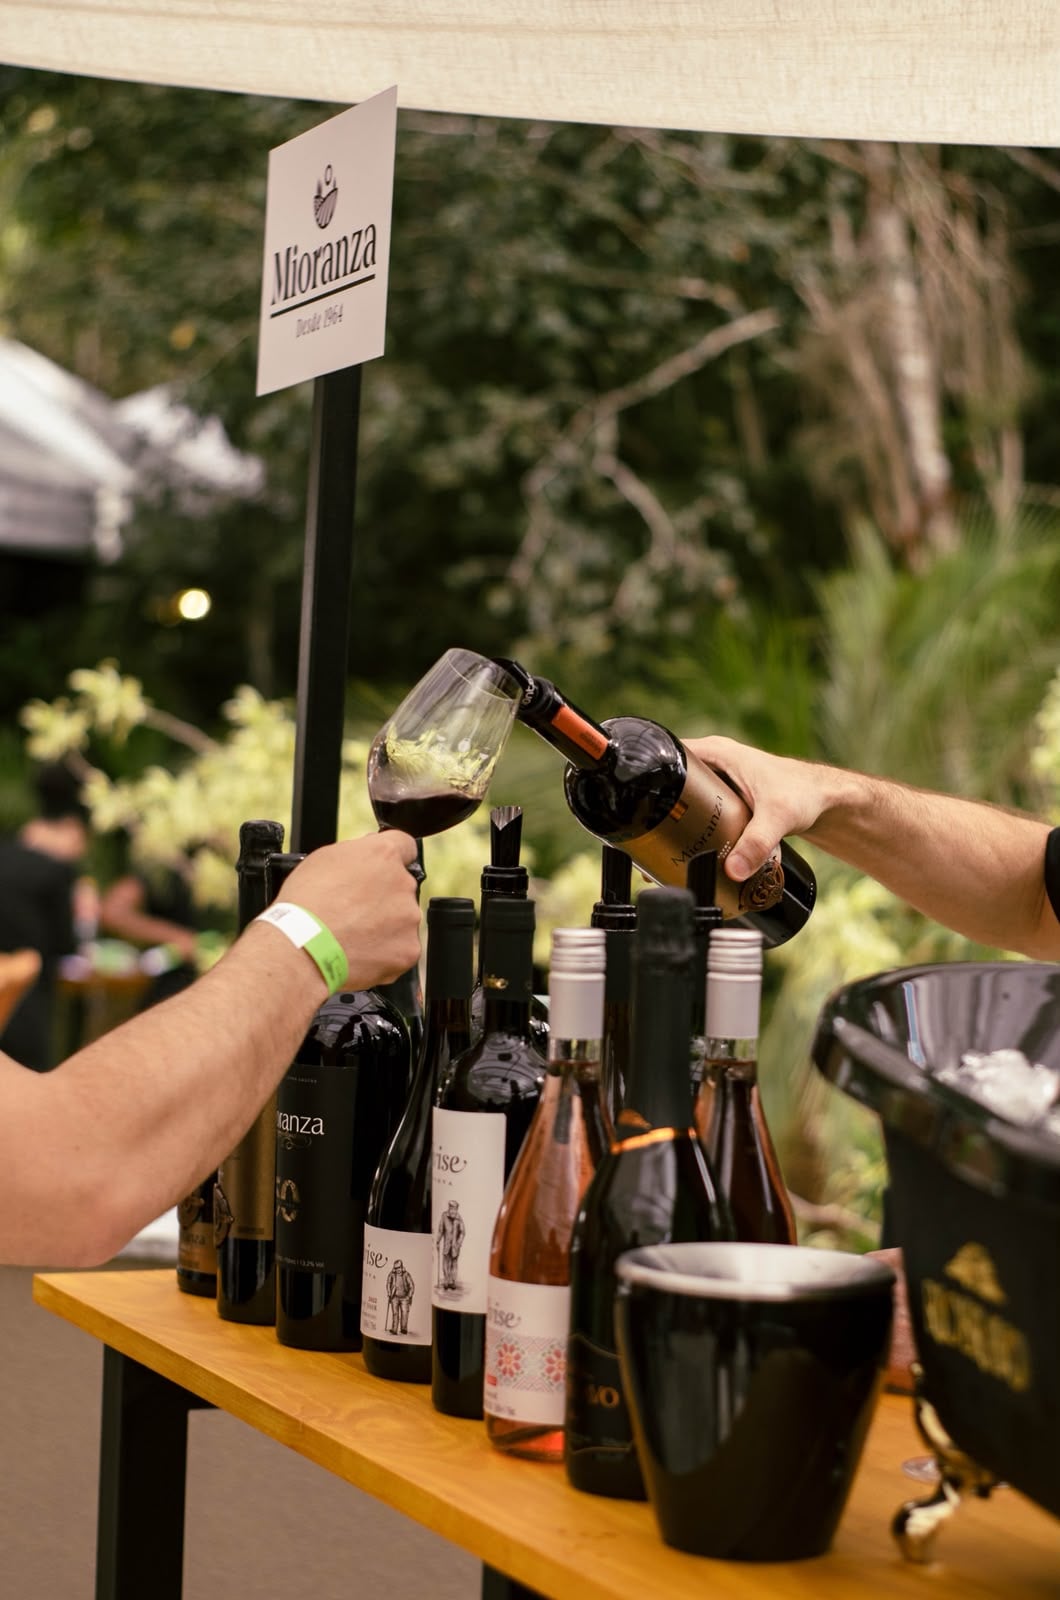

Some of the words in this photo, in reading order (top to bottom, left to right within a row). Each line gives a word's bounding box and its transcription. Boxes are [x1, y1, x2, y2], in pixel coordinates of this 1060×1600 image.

[270, 222, 378, 306] Mioranza
[295, 314, 321, 338] Desde
[323, 303, 343, 331] 1964
[433, 1145, 468, 1174] ise
[364, 1243, 389, 1269] ise
